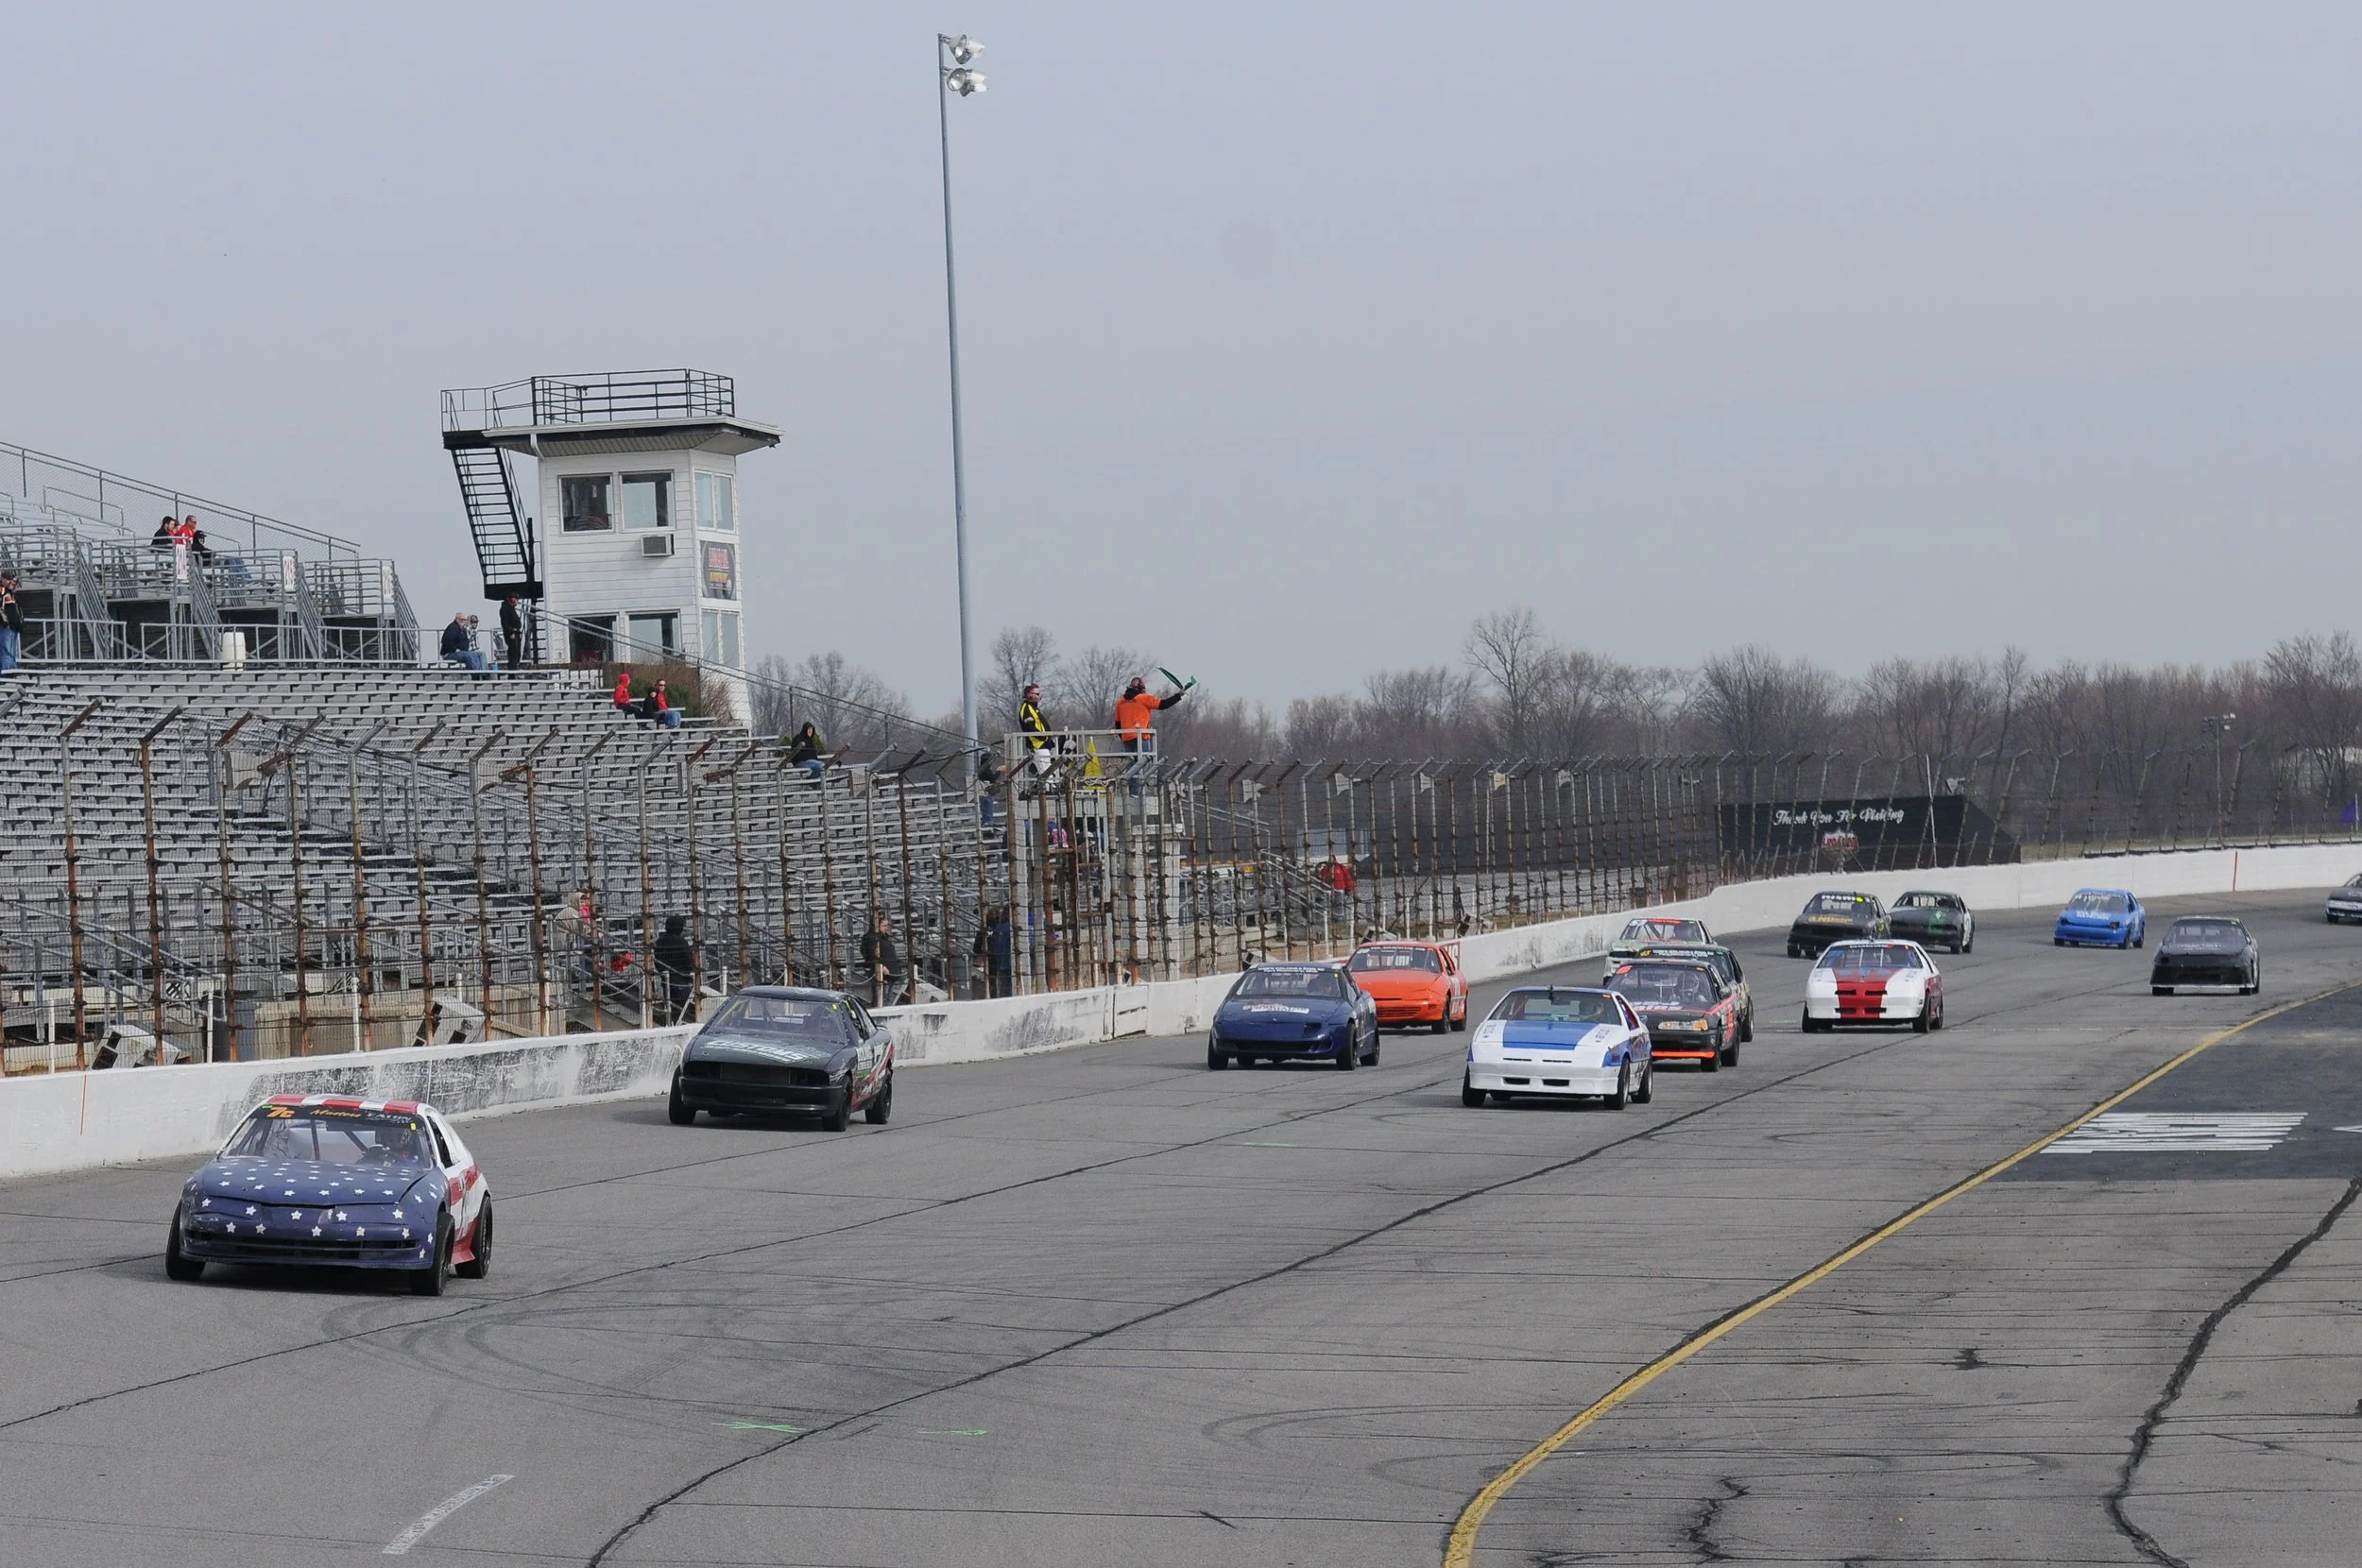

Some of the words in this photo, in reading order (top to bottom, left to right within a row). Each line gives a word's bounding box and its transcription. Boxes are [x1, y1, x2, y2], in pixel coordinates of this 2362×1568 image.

[1773, 810, 1808, 826] Thank
[1810, 810, 1833, 826] You
[1836, 810, 1857, 823] For
[1859, 808, 1905, 824] Visiting
